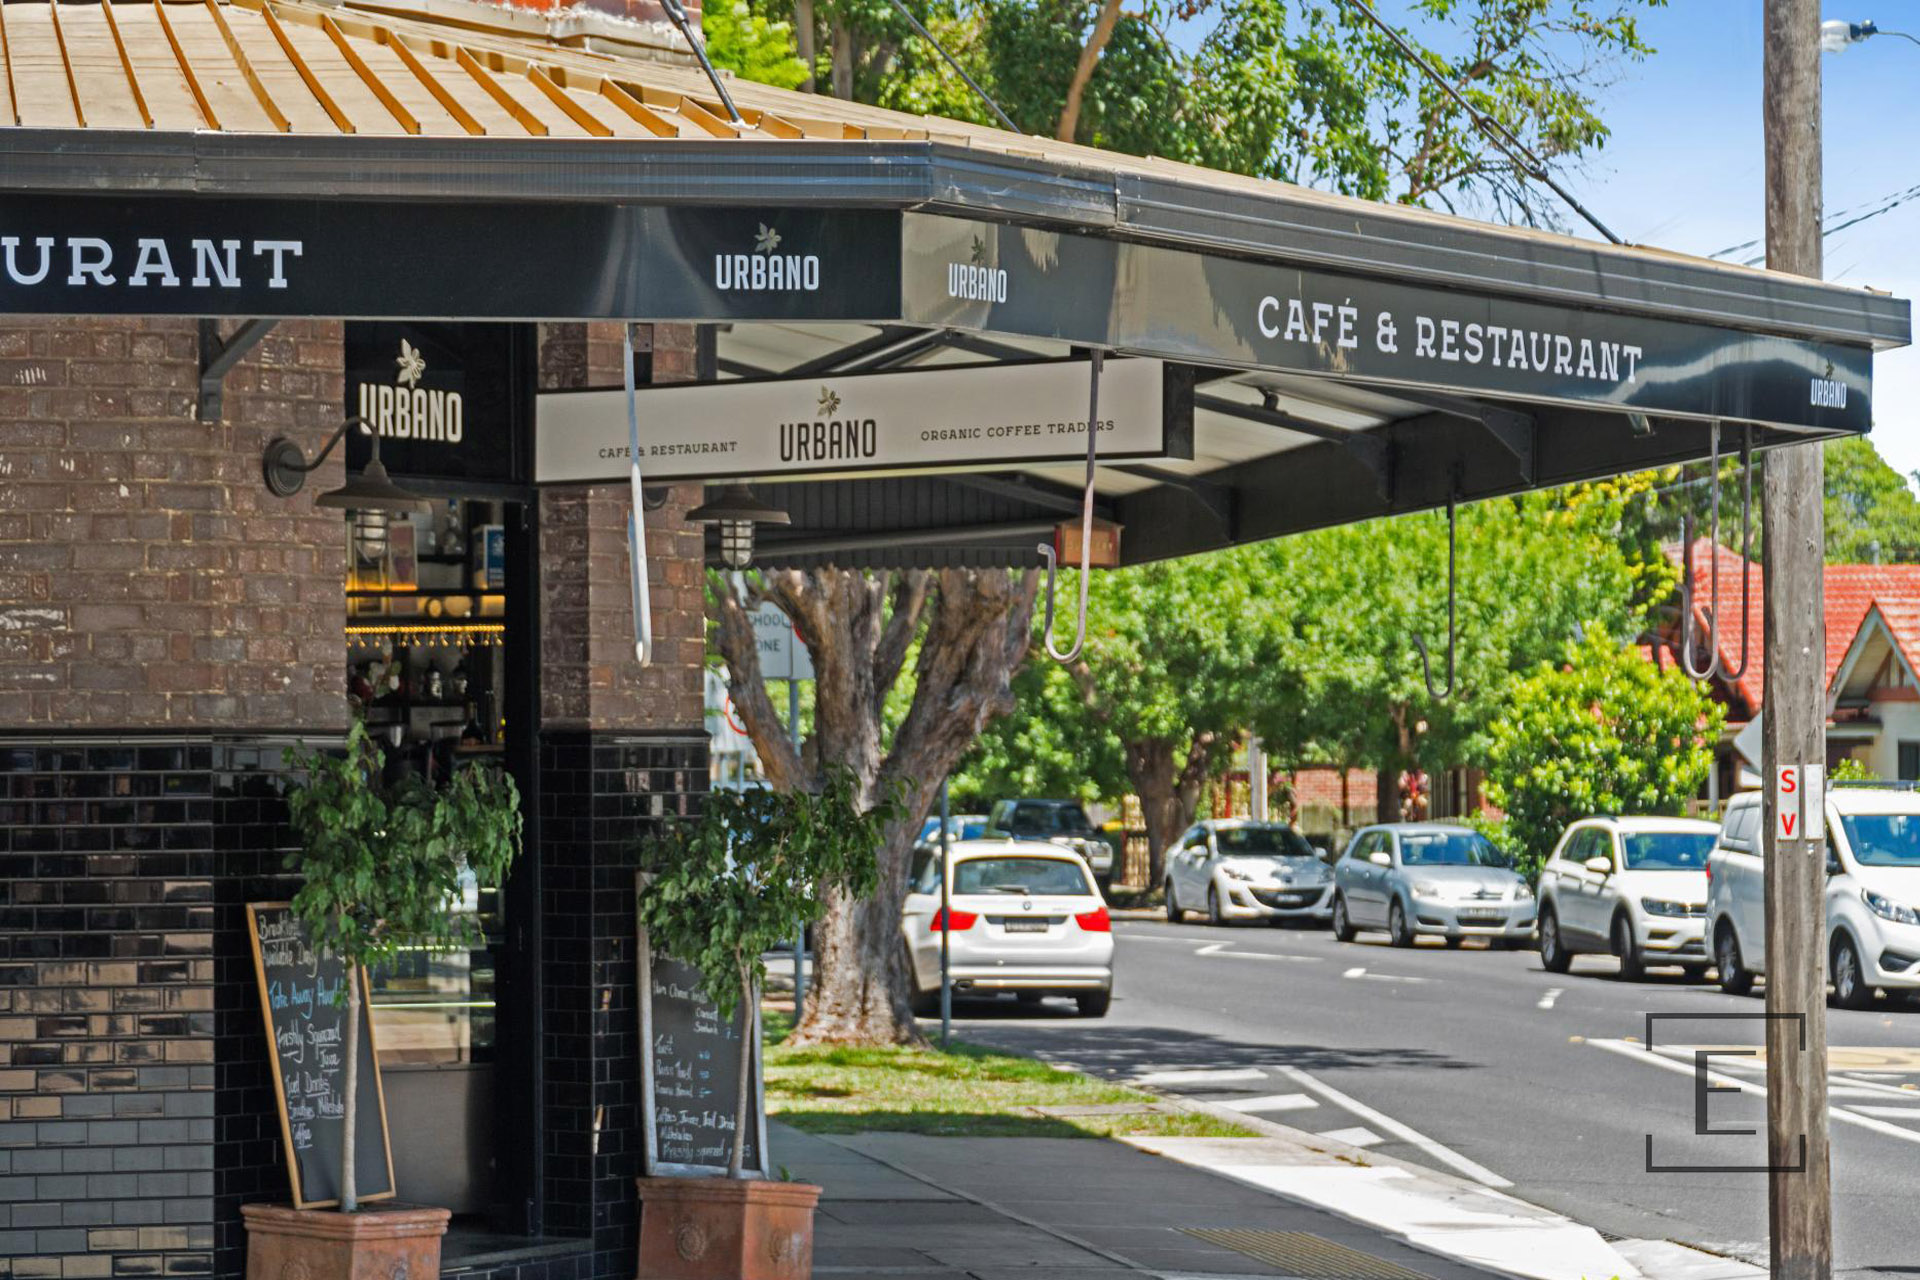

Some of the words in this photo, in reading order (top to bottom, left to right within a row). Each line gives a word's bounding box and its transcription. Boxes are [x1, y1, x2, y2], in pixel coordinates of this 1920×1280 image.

[1, 236, 303, 288] URANT
[715, 254, 820, 291] URBANO
[948, 263, 1008, 304] URBANO
[1257, 295, 1358, 348] CAFÉ
[1376, 311, 1398, 354] &
[1415, 316, 1643, 384] RESTAURANT
[359, 382, 463, 443] URBANO
[1810, 378, 1848, 409] URBANO
[650, 441, 737, 457] RESTAURANT
[779, 419, 877, 462] URBANO
[920, 427, 982, 442] ORGANIC
[986, 424, 1041, 438] COFFEE
[1047, 420, 1115, 435] TRADRS
